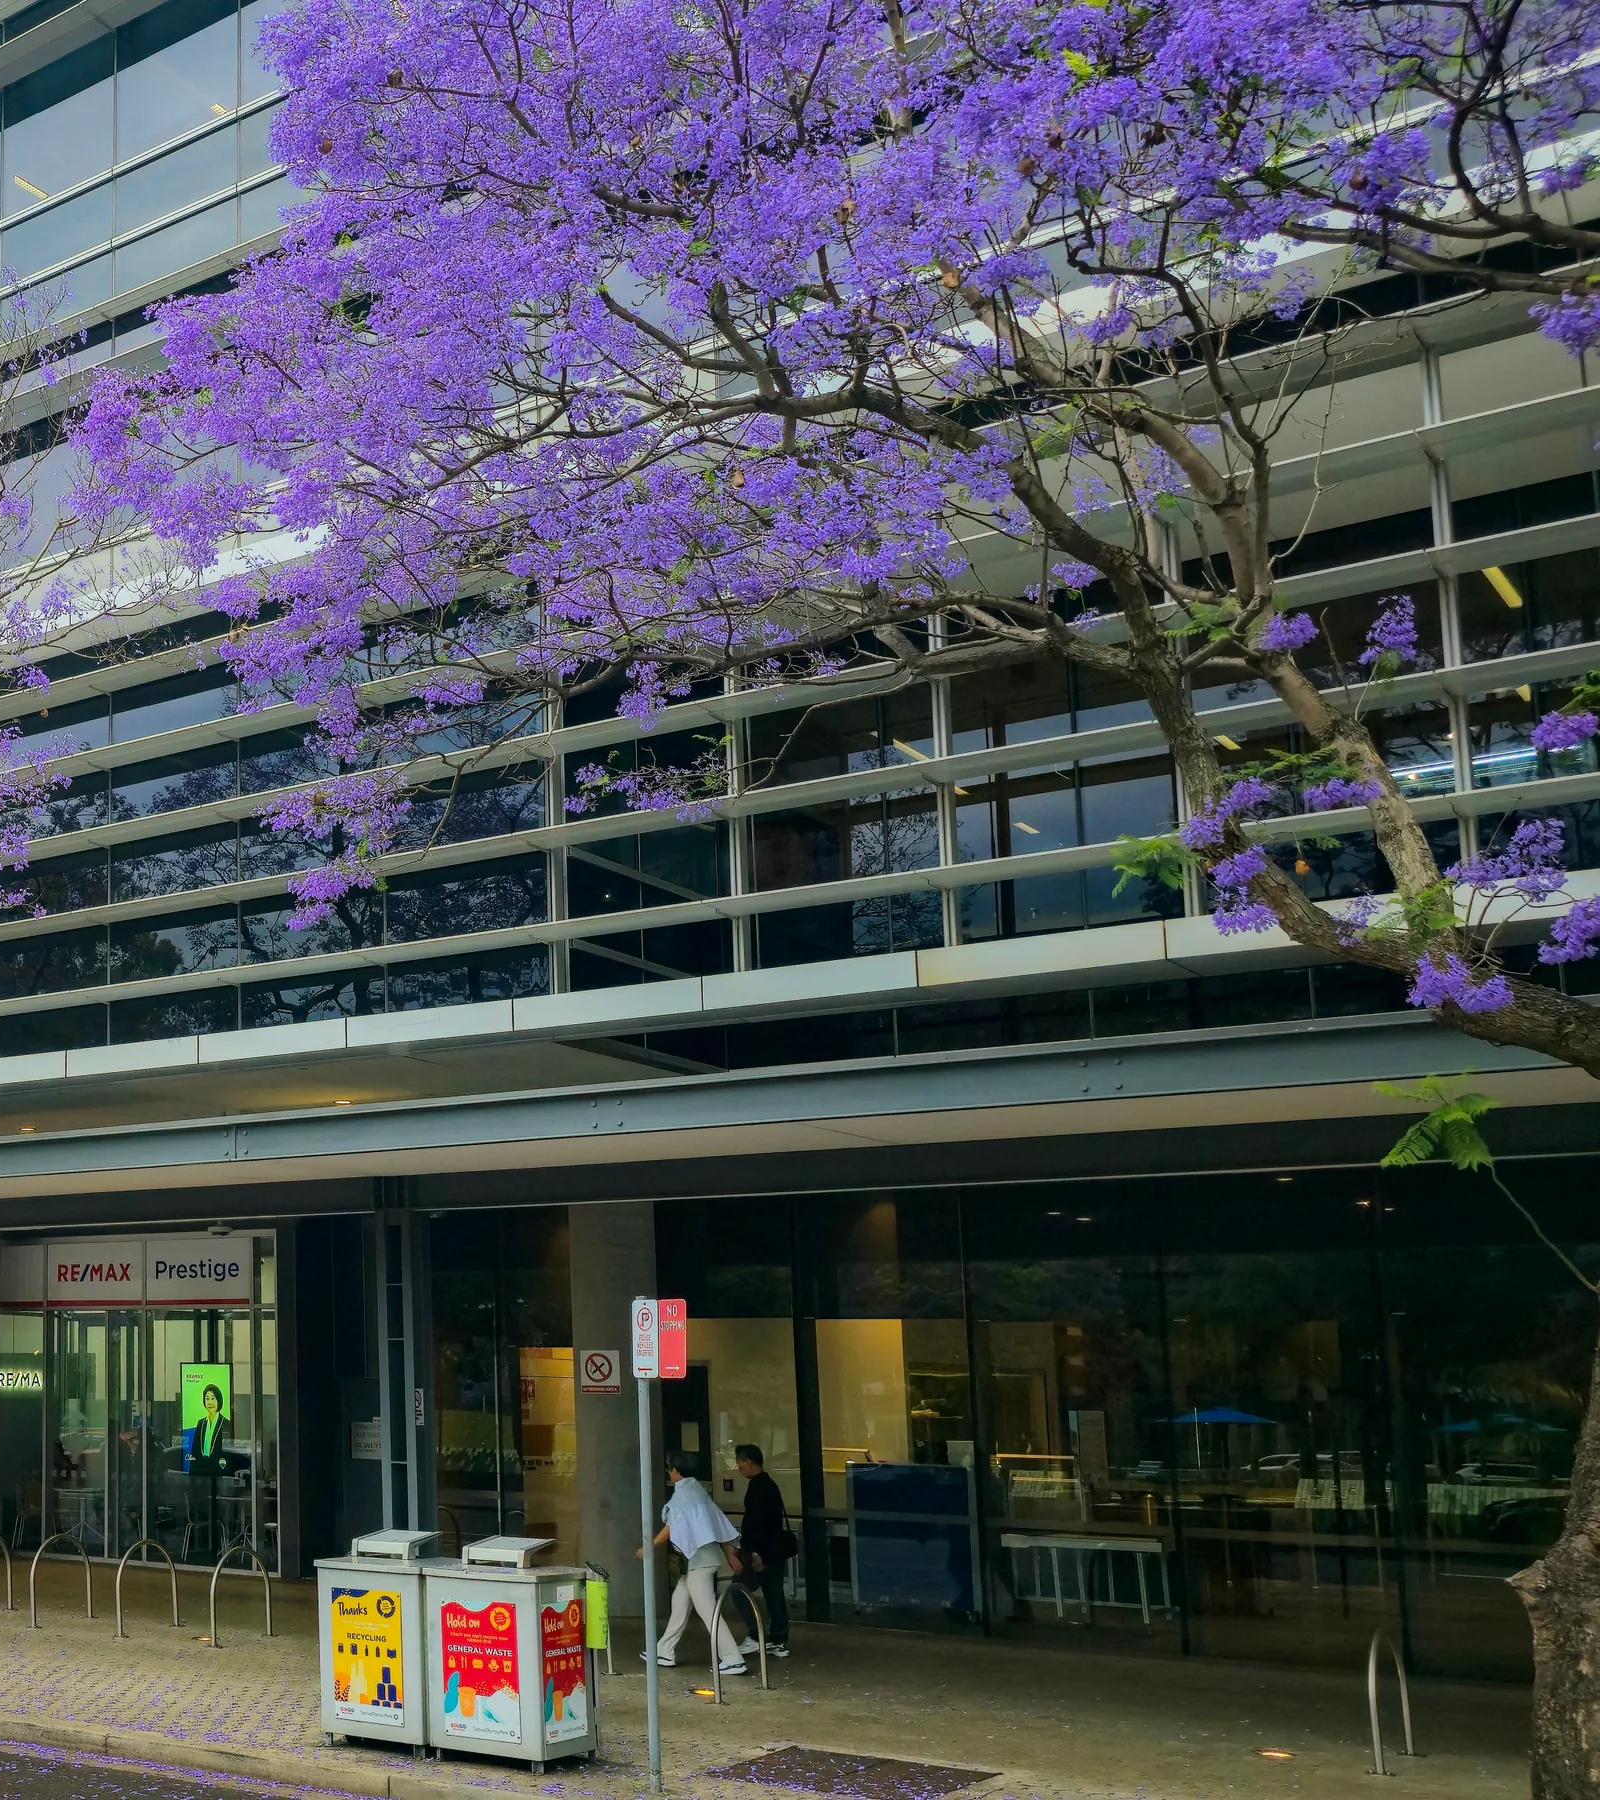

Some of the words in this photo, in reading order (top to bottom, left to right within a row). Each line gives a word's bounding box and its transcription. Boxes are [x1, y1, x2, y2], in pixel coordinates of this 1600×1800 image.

[57, 1263, 131, 1282] RE/MAX
[155, 1258, 240, 1282] Prestige
[666, 1304, 678, 1317] NO
[660, 1320, 685, 1331] STOPPING
[337, 1601, 368, 1616] Thanks
[446, 1612, 467, 1629] Hold
[468, 1618, 480, 1629] on
[544, 1617, 557, 1634] Hold
[346, 1632, 387, 1643] RECYCLING
[447, 1644, 484, 1655] GENERAL
[484, 1647, 513, 1657] WASTE
[545, 1647, 567, 1658] GENERAL
[566, 1645, 582, 1654] WASTE
